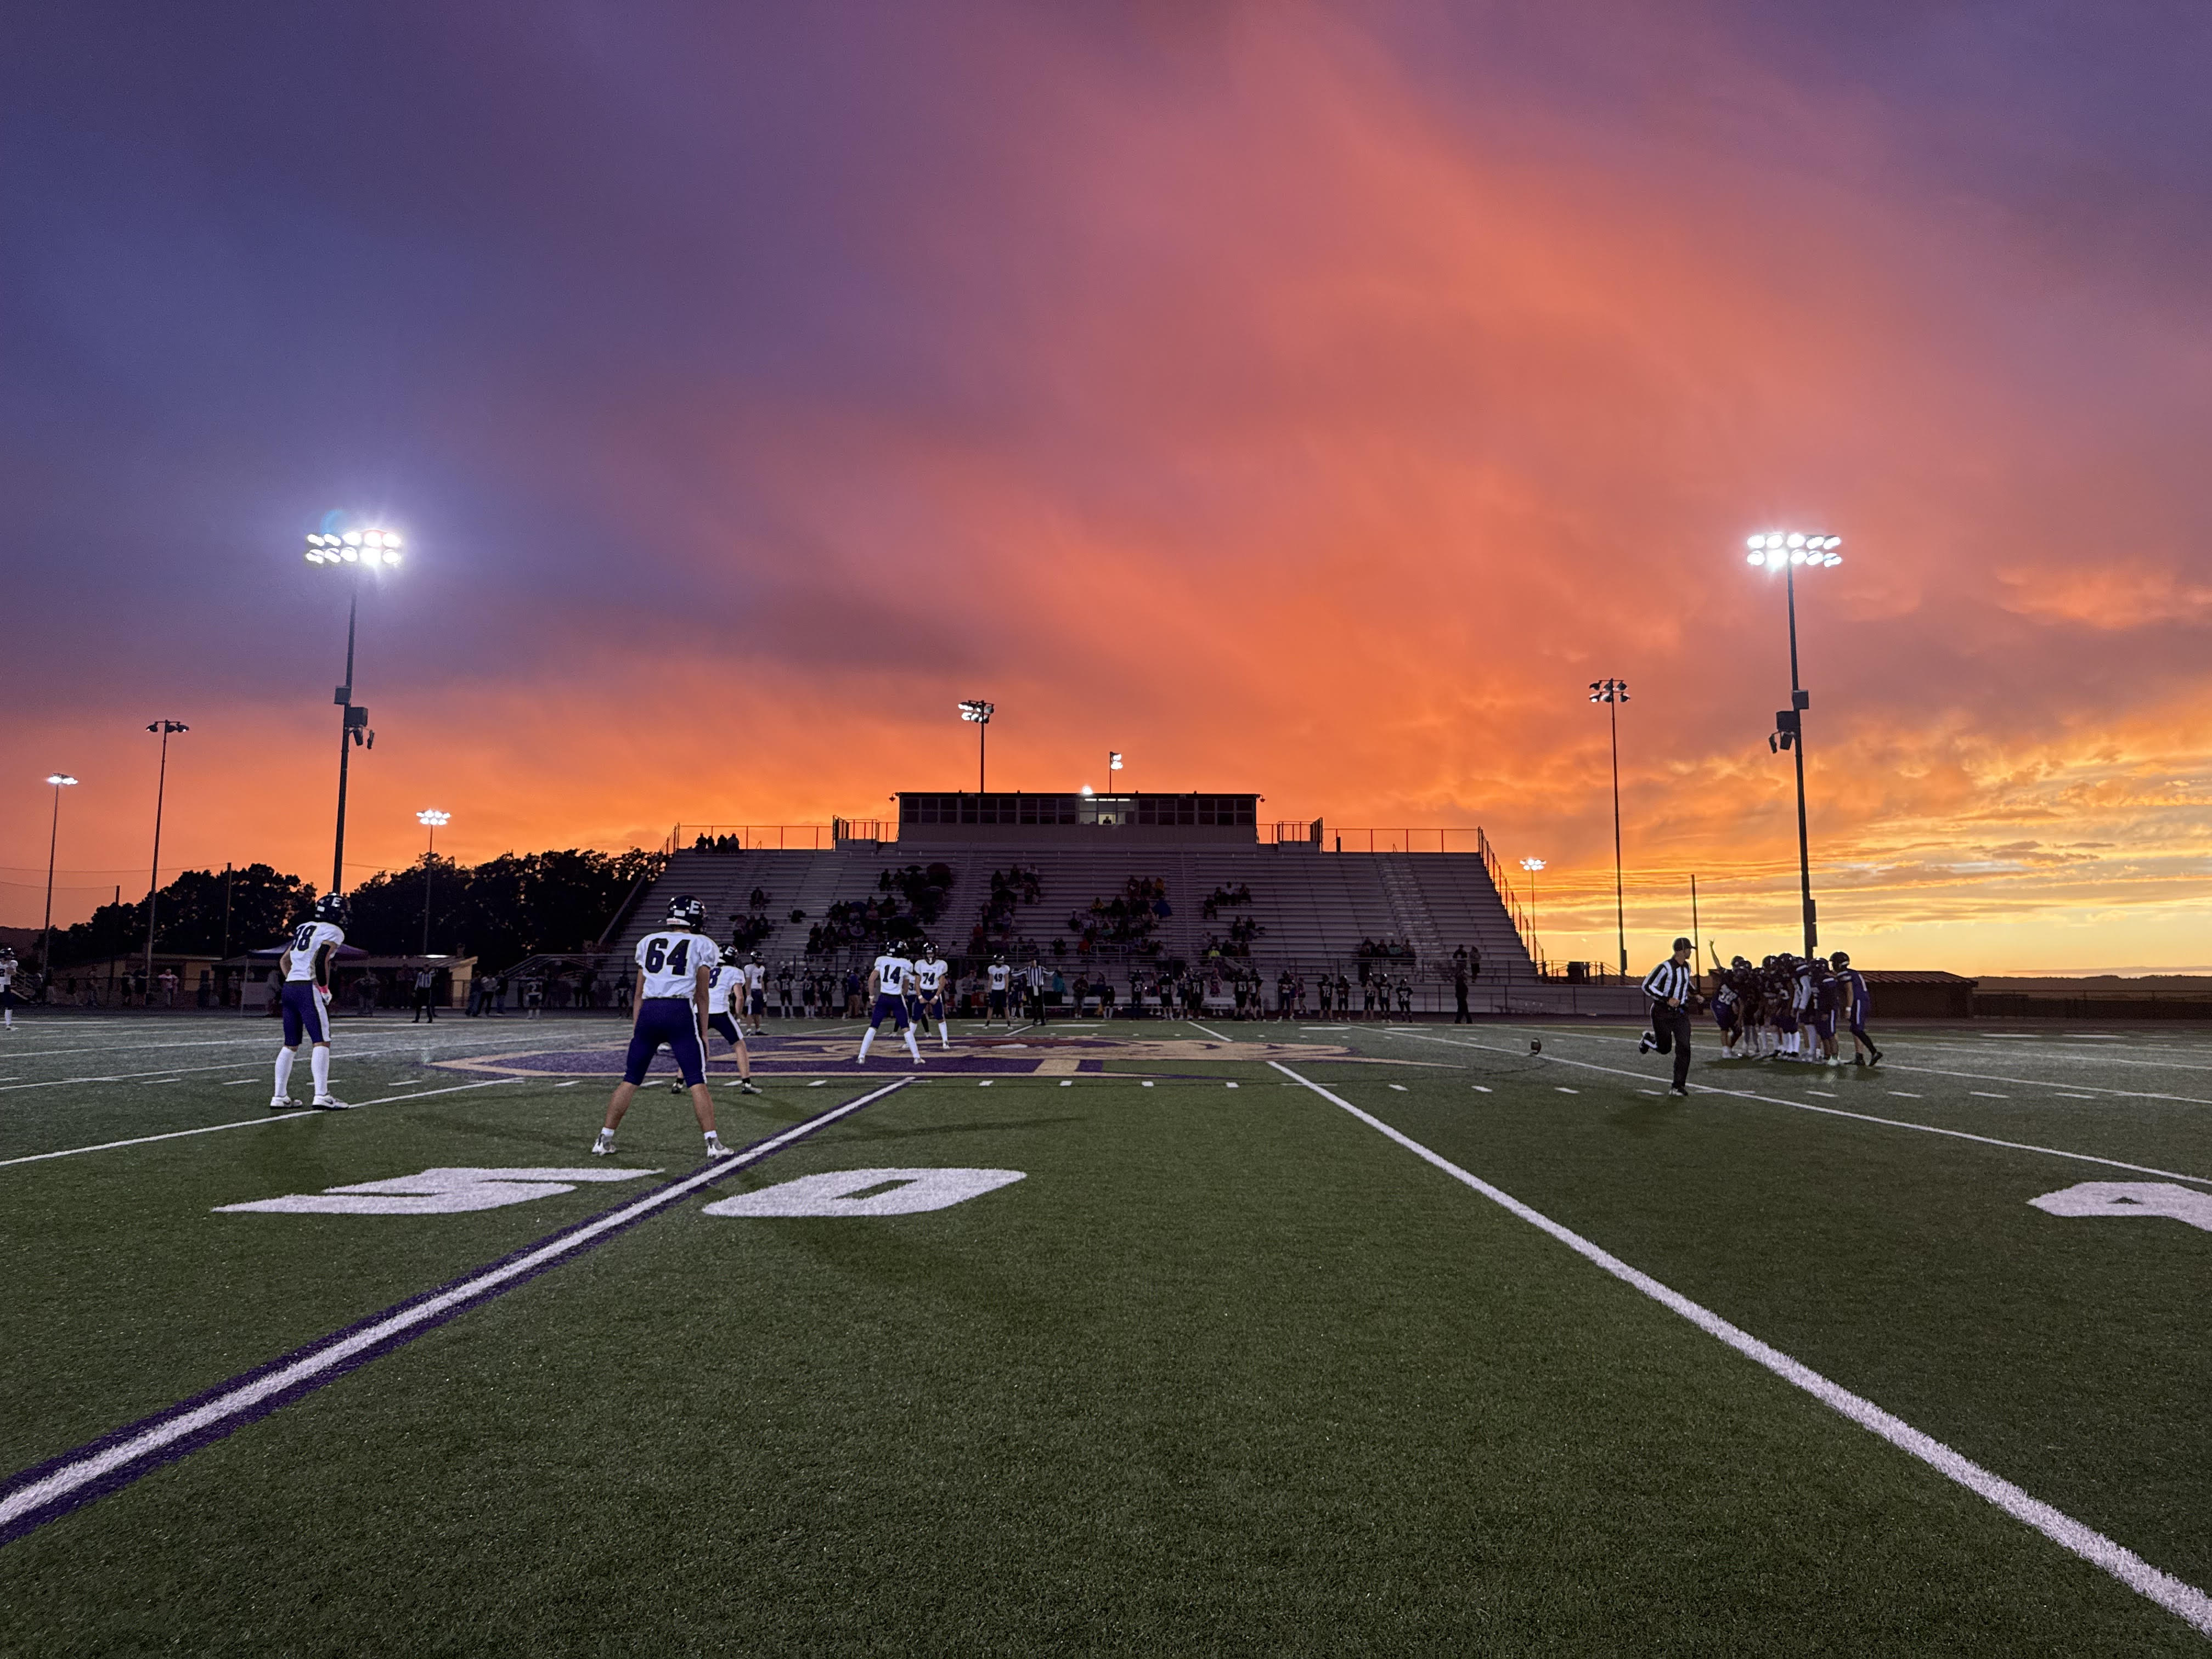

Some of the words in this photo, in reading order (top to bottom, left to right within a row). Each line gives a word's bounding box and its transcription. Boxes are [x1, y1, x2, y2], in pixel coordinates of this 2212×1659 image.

[331, 896, 343, 907] E
[689, 900, 701, 915] E
[645, 938, 691, 976] 64
[724, 945, 735, 956] E
[882, 964, 901, 985] 14
[923, 972, 936, 985] 74
[994, 973, 1003, 982] 49
